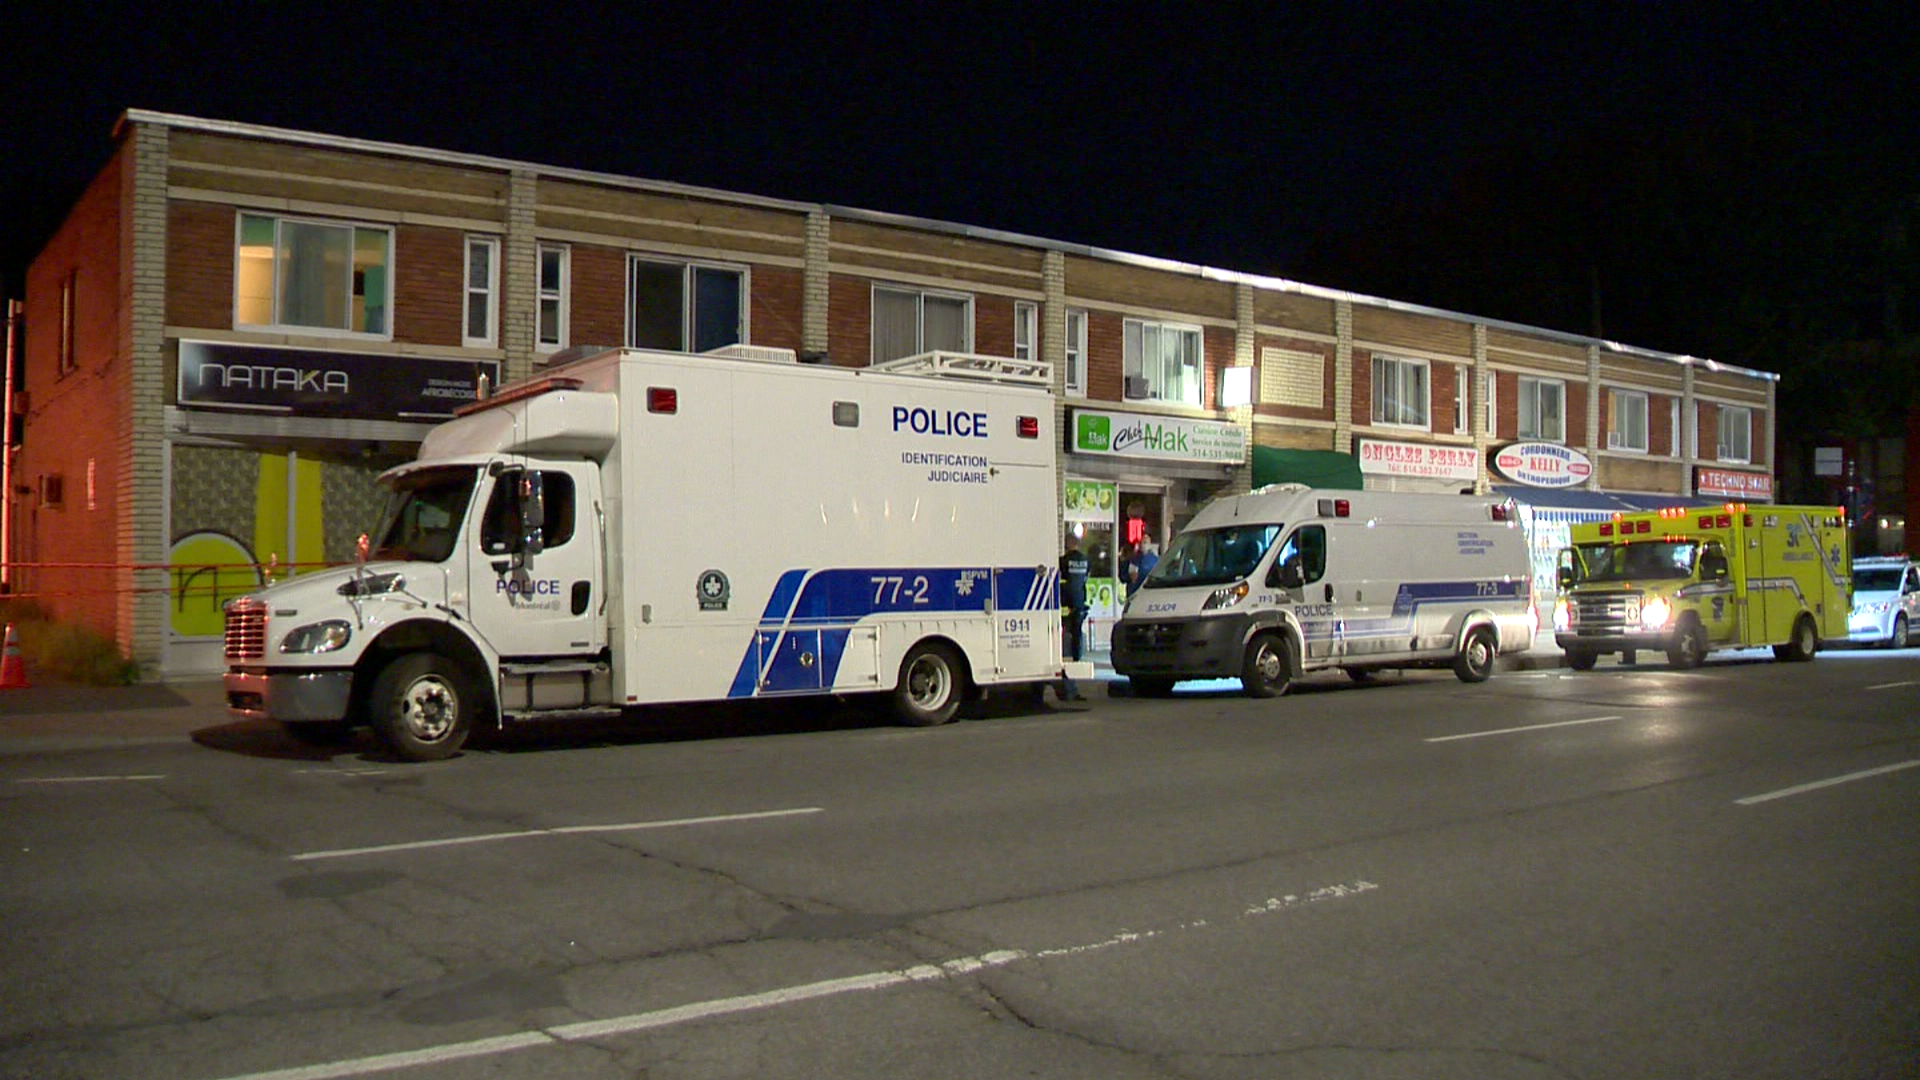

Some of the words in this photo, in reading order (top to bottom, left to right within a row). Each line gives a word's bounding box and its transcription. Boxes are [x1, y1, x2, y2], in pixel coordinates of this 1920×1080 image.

[893, 406, 988, 438] POLICE
[1144, 423, 1188, 453] Mak
[901, 452, 988, 468] IDENTIFICATION
[1428, 448, 1476, 468] PERLY
[1530, 457, 1561, 473] KELLY
[927, 470, 988, 484] JUDICIAIRE
[1708, 472, 1746, 489] TECHNO
[496, 579, 560, 595] POLICE
[871, 575, 929, 605] 77-2
[1476, 582, 1498, 596] 77-3
[1295, 603, 1334, 617] POLICE
